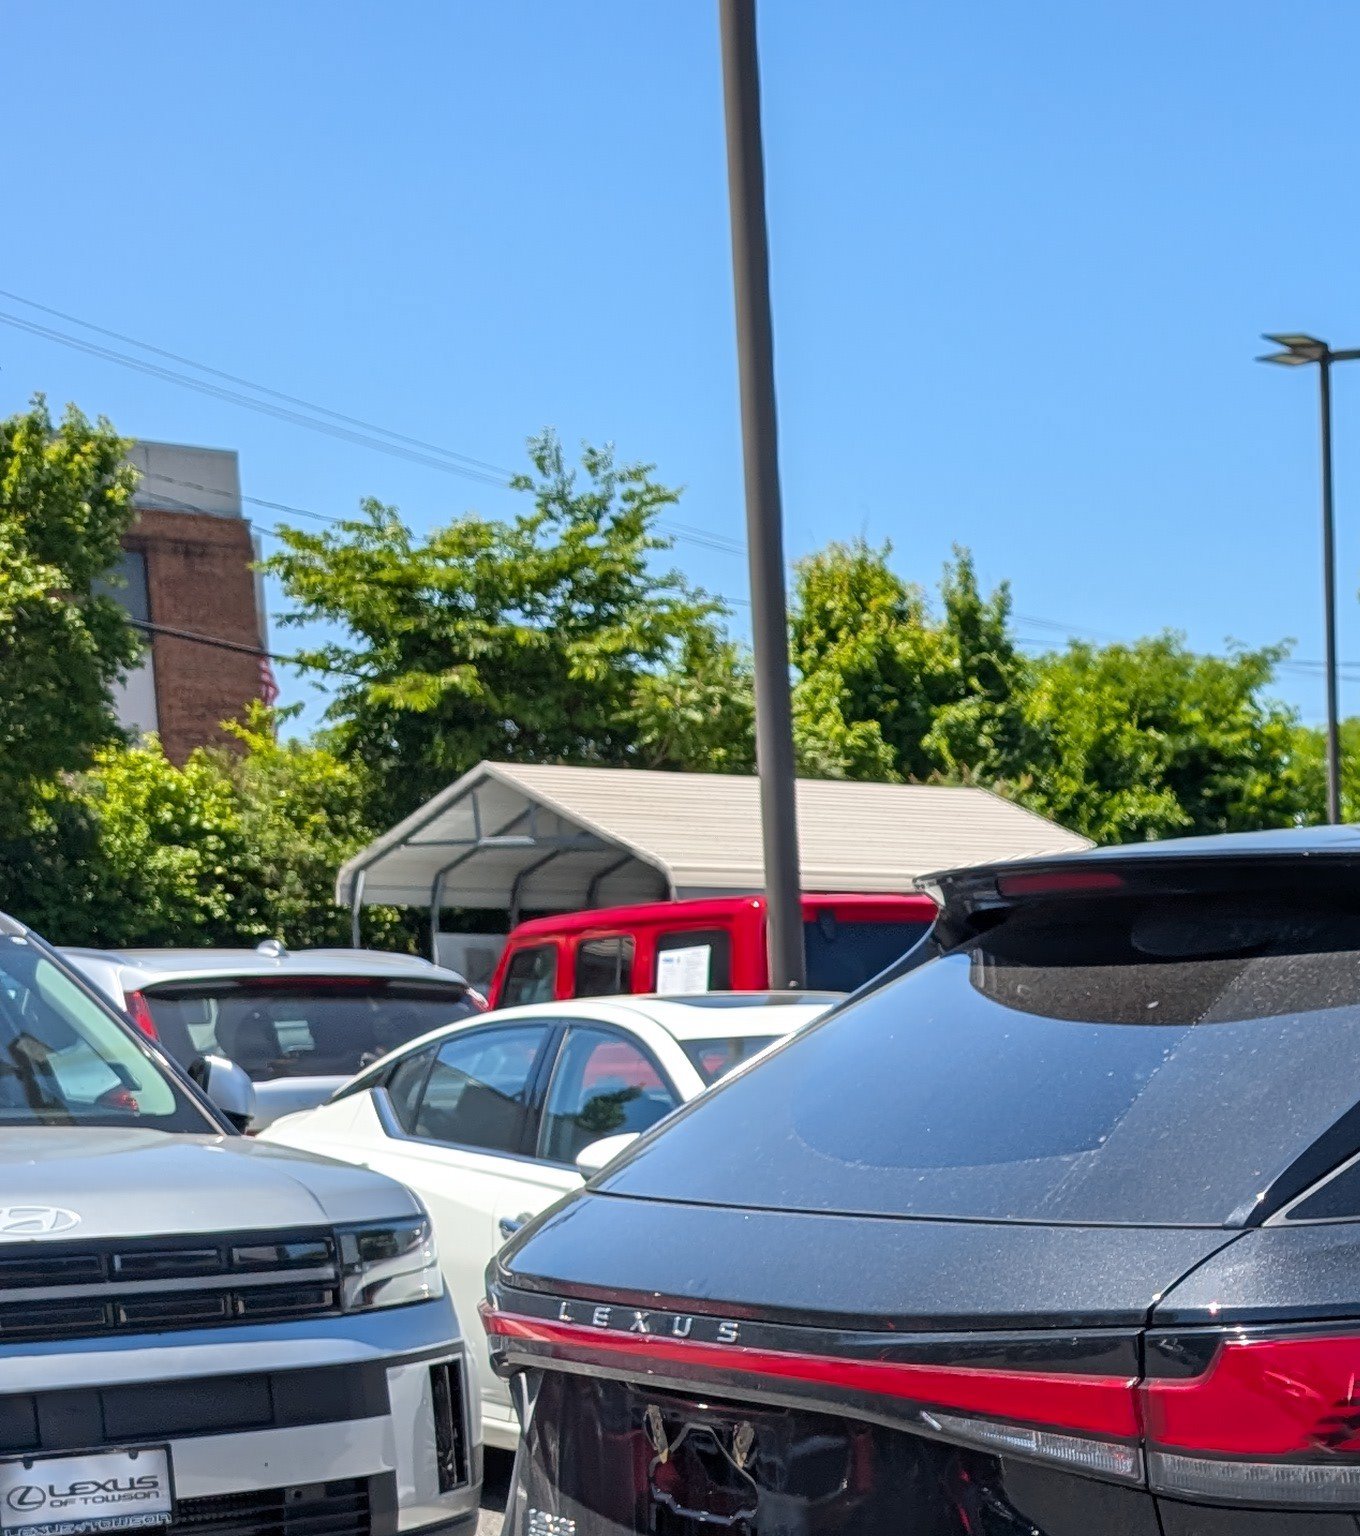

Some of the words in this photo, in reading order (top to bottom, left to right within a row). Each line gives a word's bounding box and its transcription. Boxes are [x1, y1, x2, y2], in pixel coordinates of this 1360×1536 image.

[558, 1301, 740, 1344] LEXUS
[48, 1475, 160, 1498] LEXUS
[50, 1497, 76, 1509] OF
[81, 1490, 160, 1506] TOWSON
